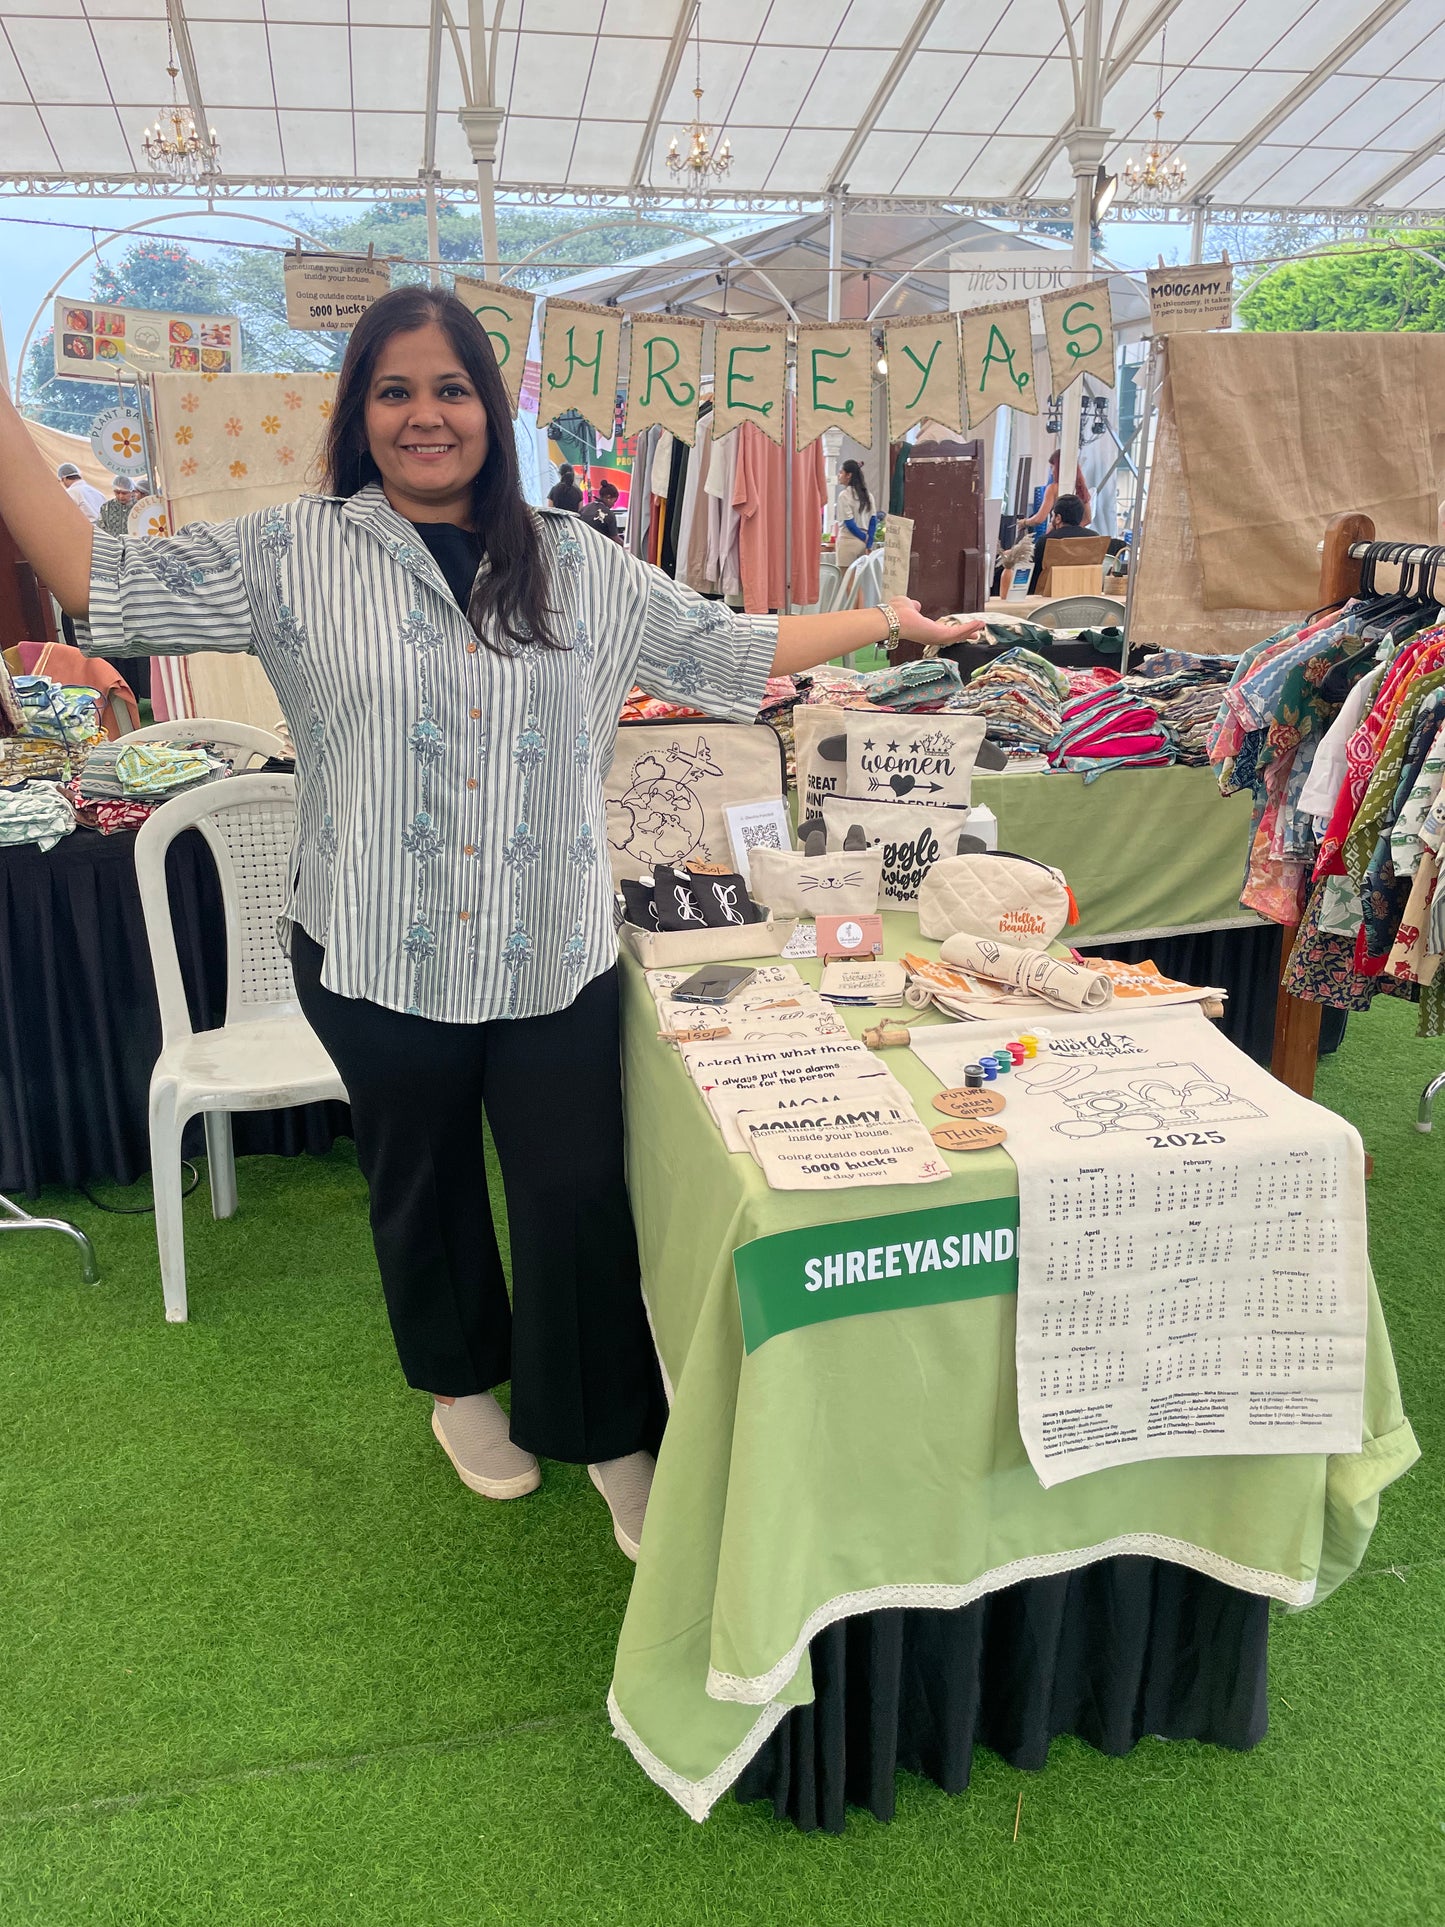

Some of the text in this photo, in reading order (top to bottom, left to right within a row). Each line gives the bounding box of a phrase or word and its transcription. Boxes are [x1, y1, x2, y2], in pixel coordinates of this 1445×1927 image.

[284, 264, 324, 272] Sometimes
[296, 291, 318, 300] Going
[320, 292, 344, 300] outside
[310, 304, 367, 317] 5000 bucks
[92, 409, 118, 438] PLANT
[106, 462, 130, 474] PLANT
[861, 754, 956, 776] women
[808, 774, 837, 790] GREAT
[885, 885, 918, 901] wiggle
[1010, 911, 1036, 924] Hello
[999, 920, 1046, 935] Beautiful
[688, 1030, 724, 1040] 150/-
[1048, 1032, 1118, 1052] World
[745, 1052, 777, 1063] him
[780, 1047, 817, 1059] what
[1088, 1046, 1150, 1058] explore
[714, 1078, 719, 1086] I
[722, 1074, 758, 1086] always
[760, 1071, 778, 1081] put
[782, 1068, 802, 1077] two
[760, 1080, 776, 1088] for
[800, 1072, 836, 1084] person
[940, 1088, 987, 1100] FUTURE
[950, 1098, 993, 1110] GREEN
[960, 1106, 994, 1115] GIFTS
[748, 1110, 880, 1132] MONOGAMY
[788, 1128, 893, 1142] inside your house.
[936, 1125, 1004, 1140] THINK
[1146, 1130, 1226, 1148] 2025
[778, 1144, 914, 1162] Going outside costs like
[801, 1156, 898, 1174] 5000 bucks
[1080, 1167, 1104, 1175] January
[833, 1172, 856, 1180] day
[858, 1170, 888, 1178] now!
[804, 1226, 1020, 1292] SHREEYASIND
[1178, 1276, 1198, 1284] August
[1168, 1332, 1198, 1341] November
